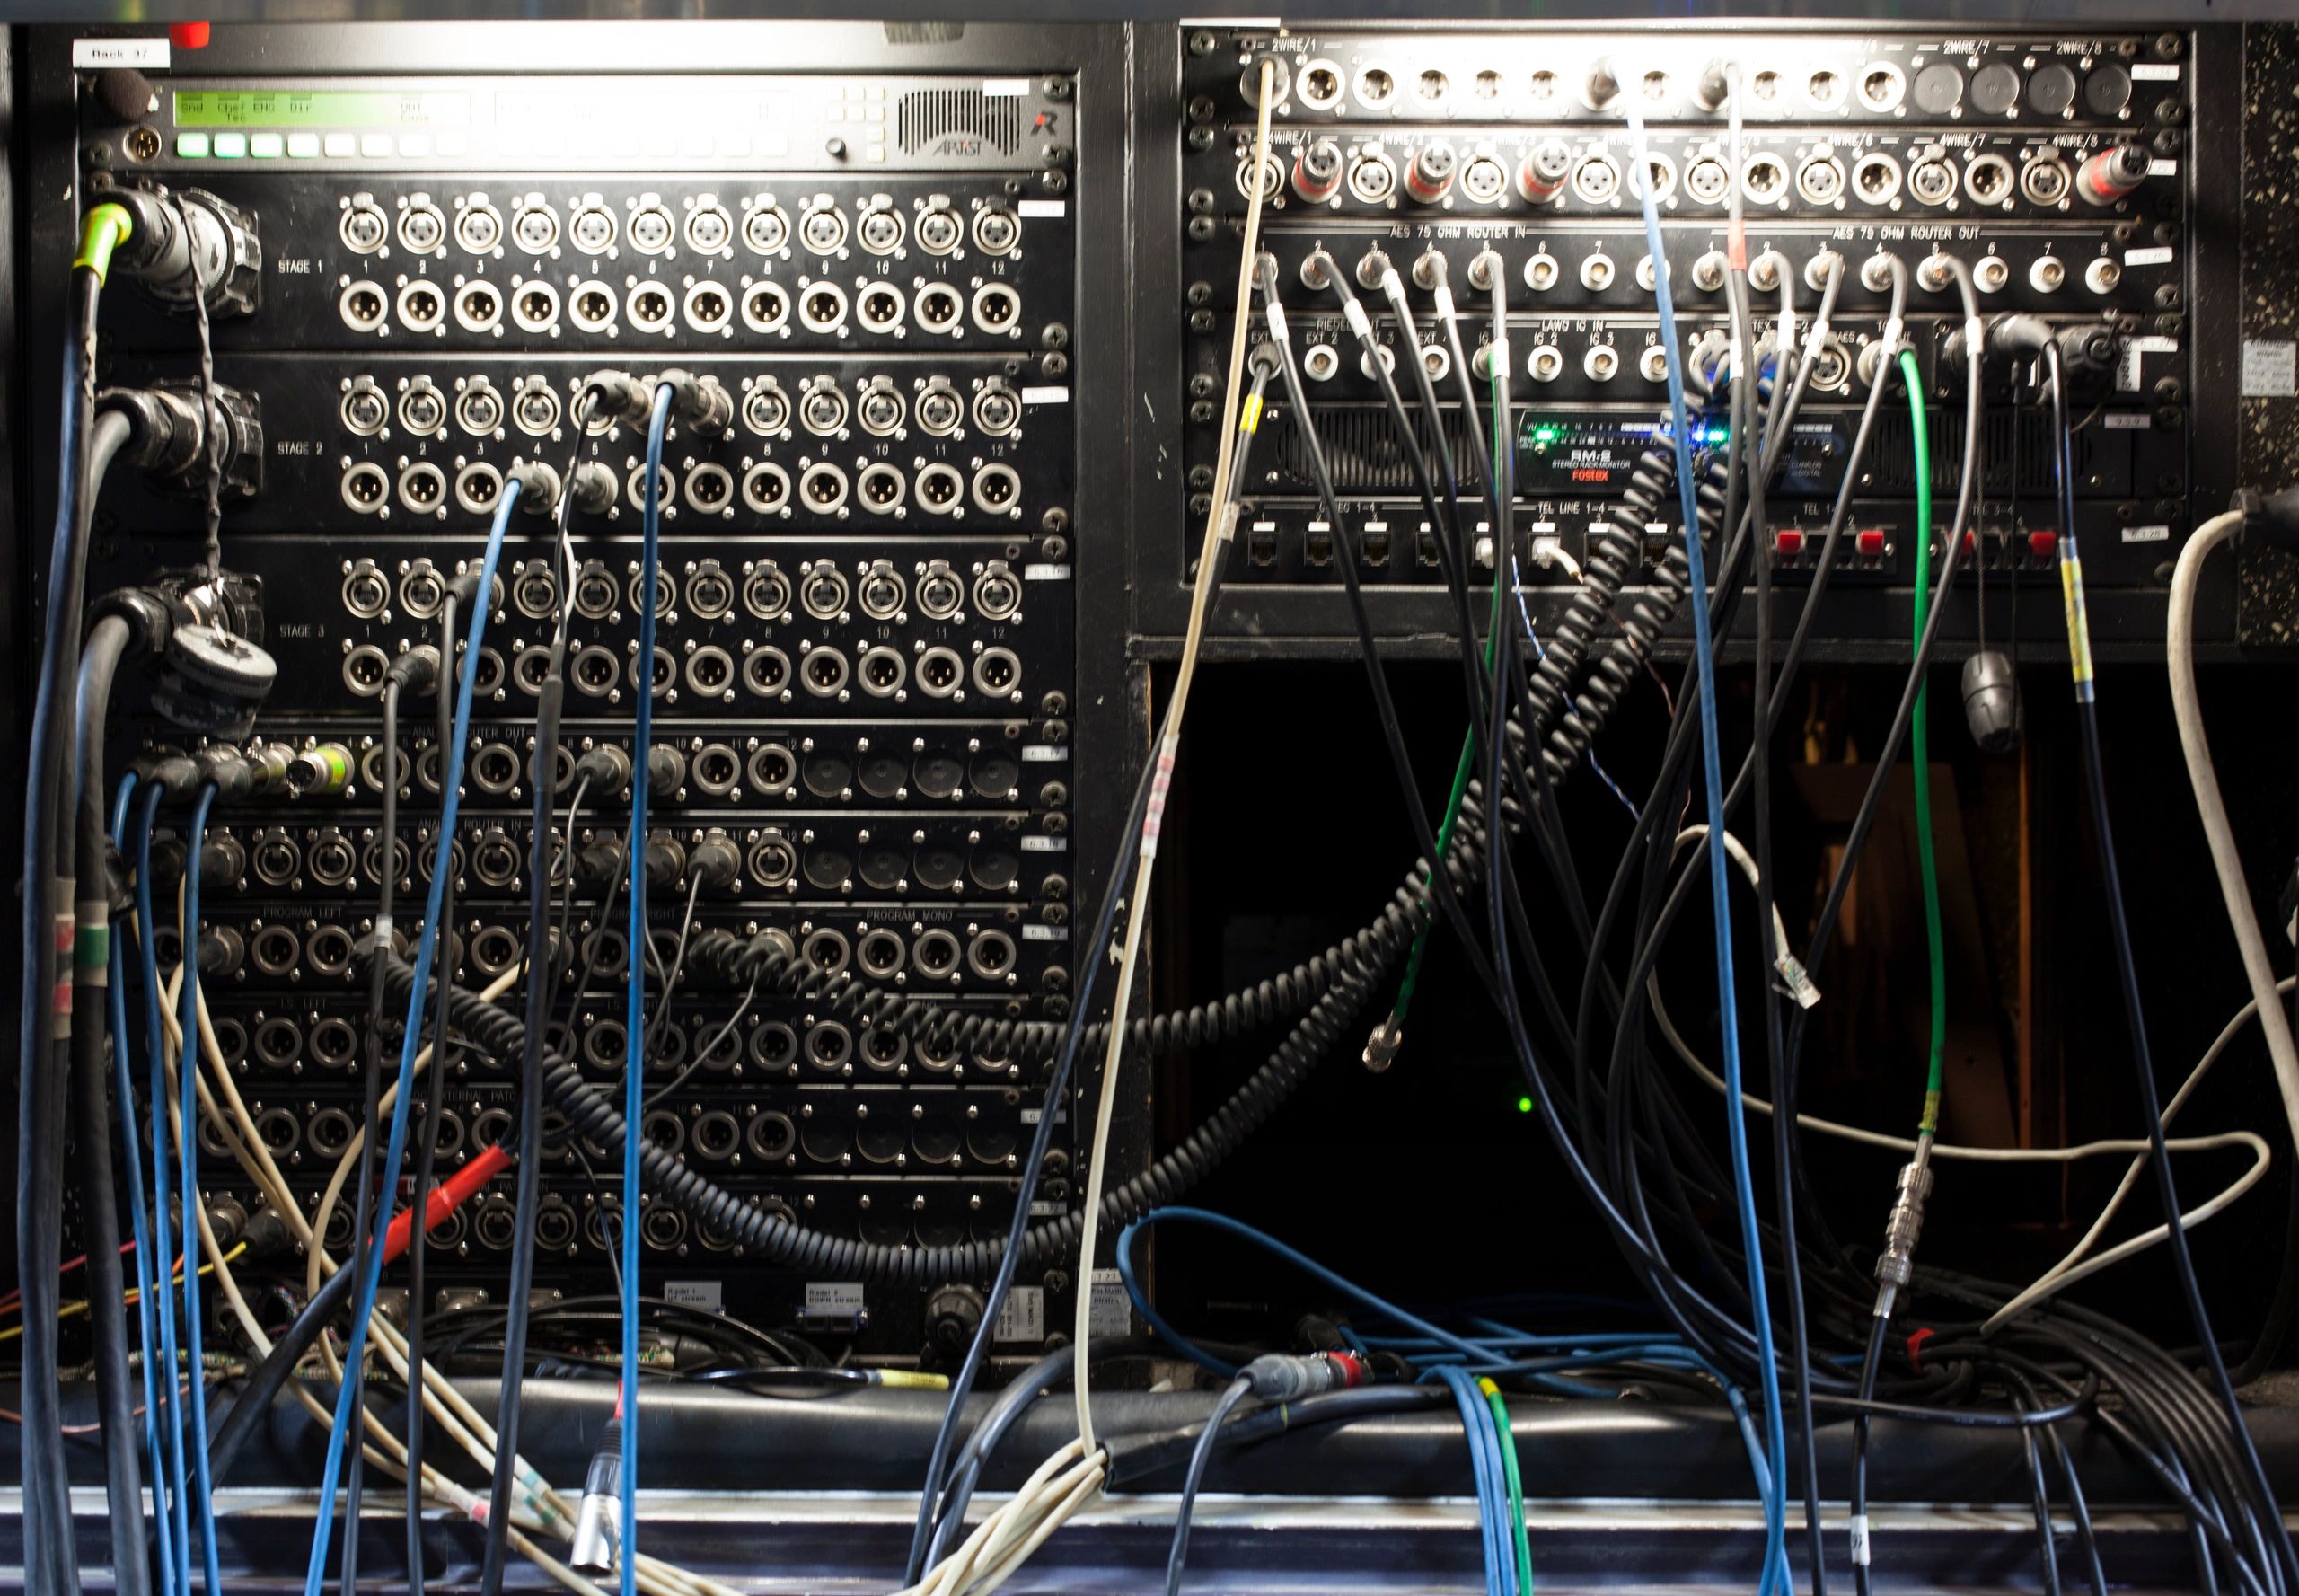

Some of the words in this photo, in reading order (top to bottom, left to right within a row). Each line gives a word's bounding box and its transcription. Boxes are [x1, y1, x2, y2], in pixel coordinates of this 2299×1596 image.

[1272, 37, 1316, 52] 2WIRE/1
[1943, 40, 1990, 55] 2WIRE/7
[2057, 40, 2102, 55] 2WIRE/8
[1940, 132, 1986, 147] 4WIRE/7
[2053, 133, 2099, 147] 4WIRE/8
[932, 138, 982, 157] ARTIST
[1390, 225, 1410, 239] AES
[1417, 225, 1431, 239] 75
[1438, 225, 1460, 239] OHM
[1467, 225, 1509, 239] ROUTER
[1515, 225, 1526, 239] IN
[1833, 226, 1854, 240] AES
[1861, 226, 1874, 240] 75
[1881, 226, 1904, 240] OHM
[1910, 226, 1952, 240] ROUTER
[1959, 226, 1980, 240] OUT
[1595, 240, 1602, 253] 7
[2045, 242, 2052, 255] 7
[278, 260, 310, 273] STAGE
[1542, 320, 1570, 332] LAWO
[1593, 320, 1603, 332] IN
[1306, 331, 1324, 344] EXT
[278, 442, 310, 456] STAGE
[1538, 502, 1555, 515] TEL
[1559, 502, 1581, 515] LINE
[1803, 502, 1820, 516] TEL
[279, 625, 312, 639] STAGE
[505, 726, 526, 738] OUT
[732, 736, 742, 749] 11
[264, 905, 314, 919] PROGRAM
[320, 905, 342, 919] LEFT
[867, 909, 916, 921] PROGRAM
[922, 909, 953, 921] MONO
[436, 1089, 481, 1101] XTERNAL
